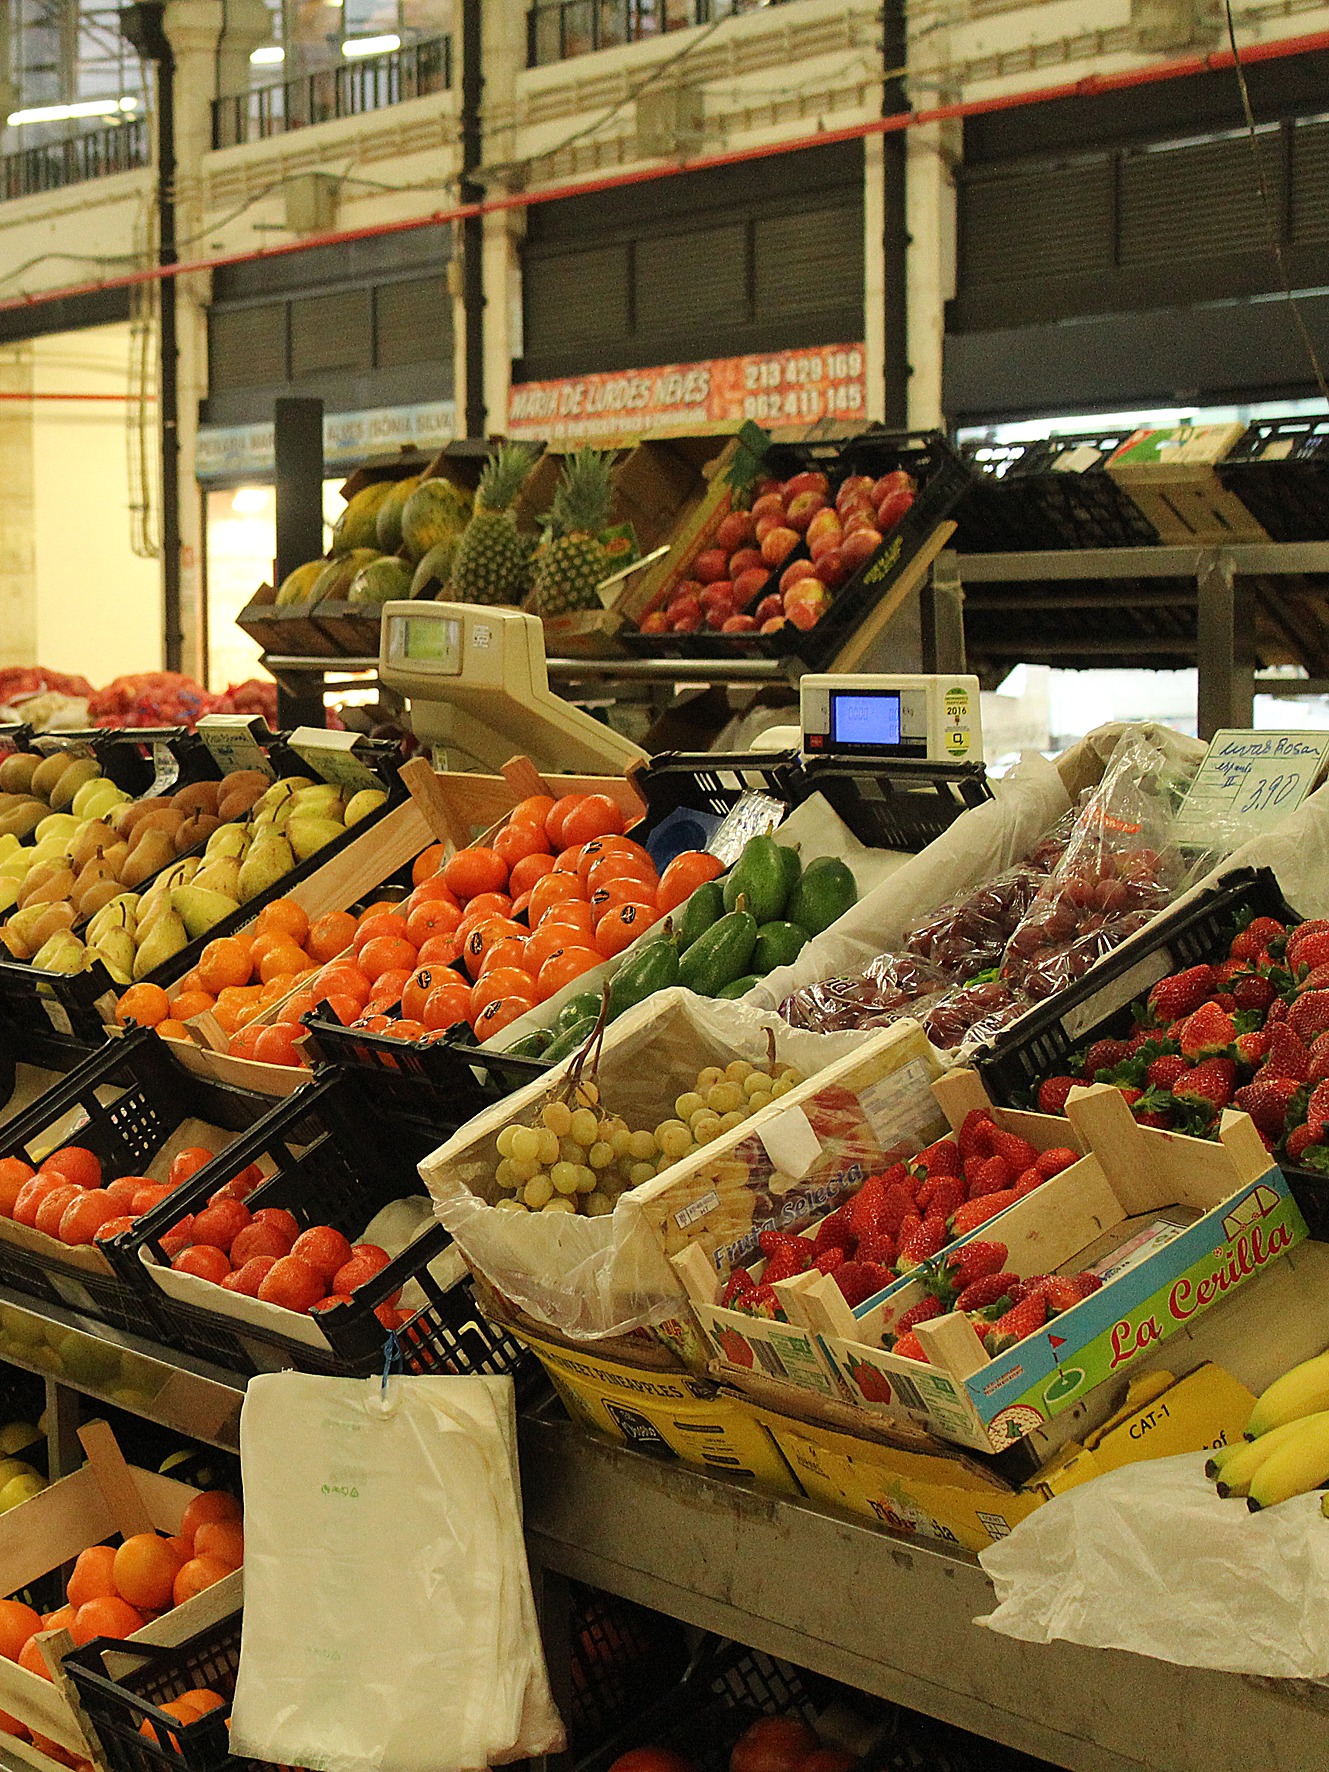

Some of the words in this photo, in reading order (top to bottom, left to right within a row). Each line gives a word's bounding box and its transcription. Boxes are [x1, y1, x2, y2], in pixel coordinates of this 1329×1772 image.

[745, 361, 782, 390] 213
[509, 388, 559, 421] MARIA
[559, 382, 586, 416] DE
[651, 369, 711, 405] NEVES
[827, 383, 863, 412] 145
[947, 706, 968, 715] 2016
[713, 1217, 777, 1271] Fruta
[781, 1163, 864, 1227] Selecta
[1109, 1319, 1163, 1370] La
[1168, 1221, 1294, 1320] Cerilla
[592, 1366, 685, 1400] PINEAPPLES
[1129, 1404, 1170, 1440] CAT-1
[1212, 1429, 1228, 1450] of
